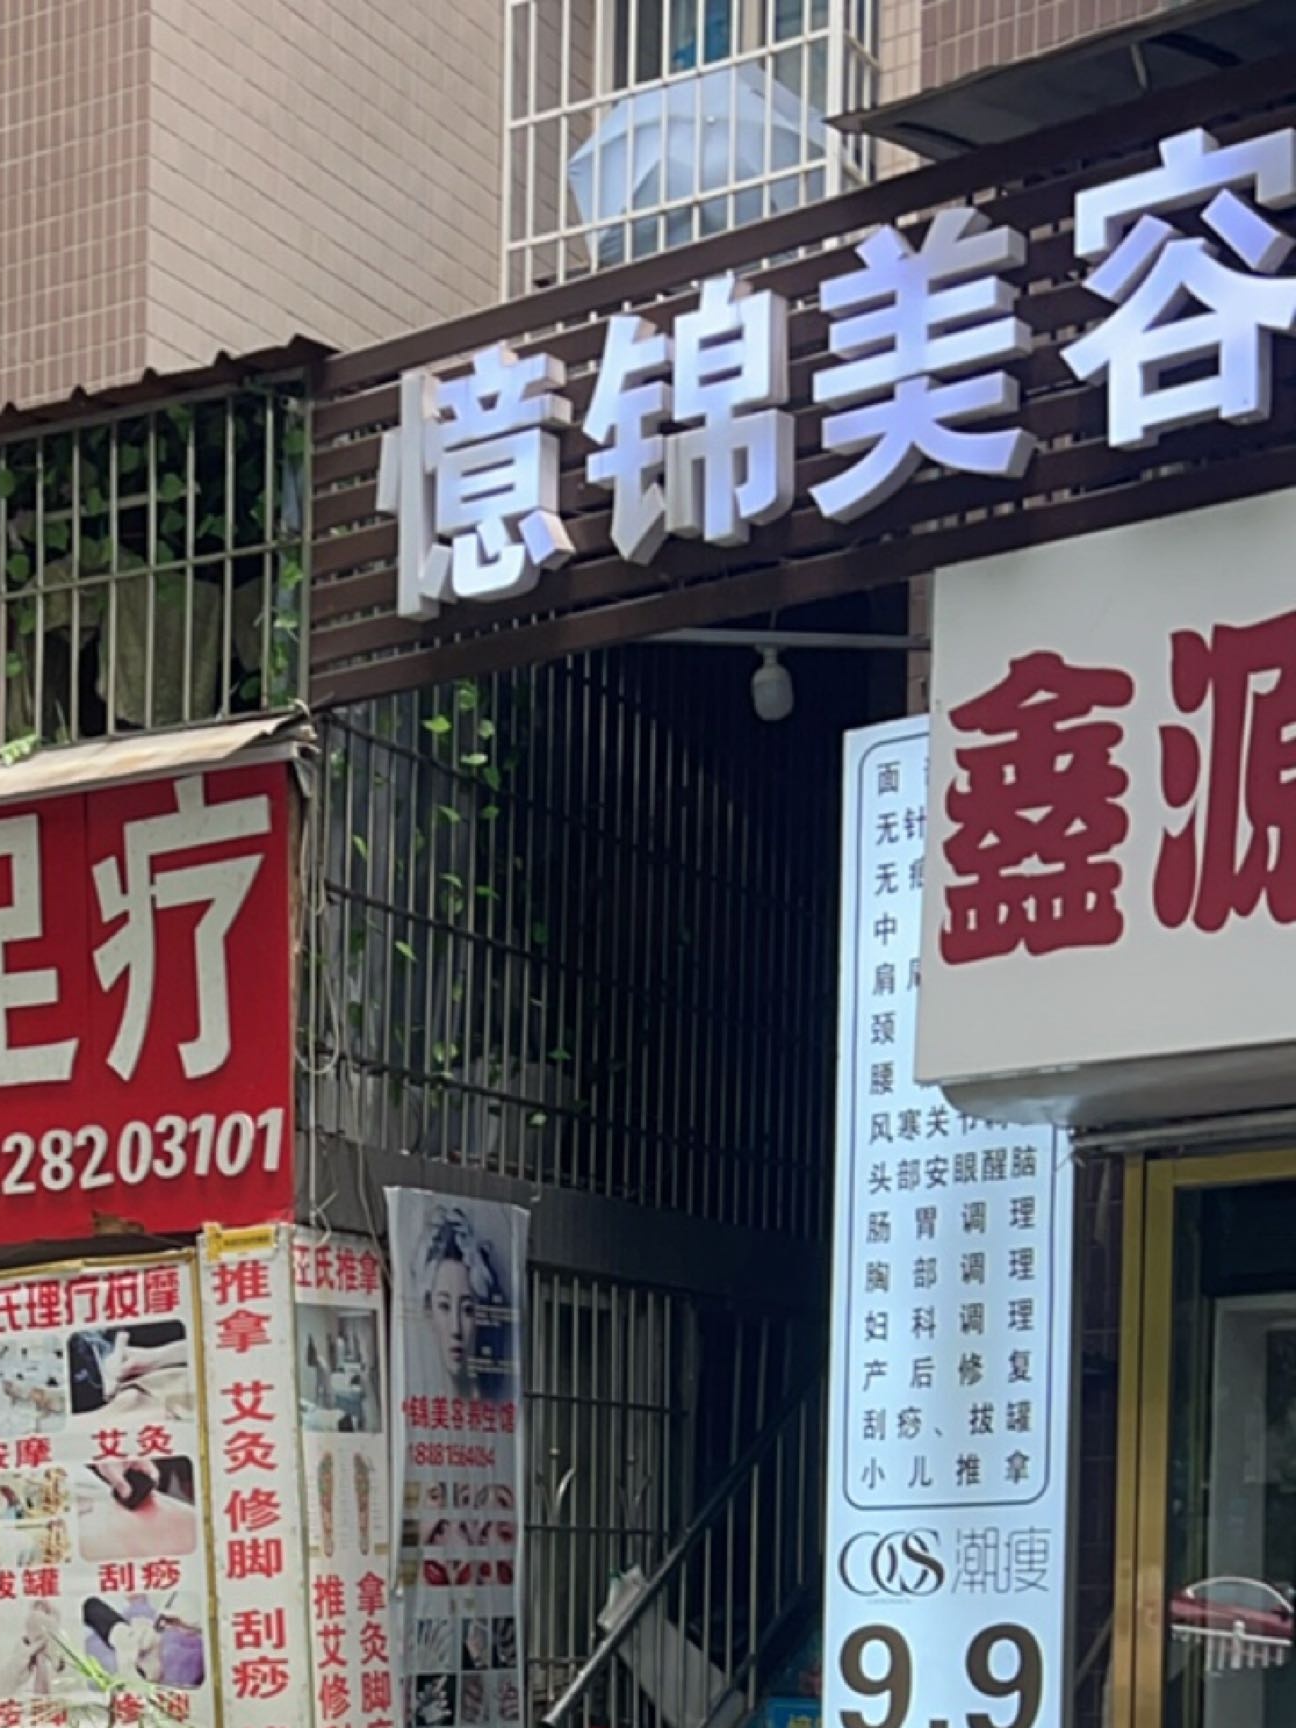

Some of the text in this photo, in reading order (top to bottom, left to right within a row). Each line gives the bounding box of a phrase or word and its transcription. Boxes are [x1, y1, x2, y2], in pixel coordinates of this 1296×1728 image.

[866, 1196, 1036, 1245] 肠胃调理
[865, 1247, 1036, 1295] 胸部调理
[865, 1297, 1035, 1343] 妇科调理
[863, 1348, 1033, 1392] 产后修复
[91, 1425, 173, 1461] 艾灸
[861, 1448, 1031, 1490] 小儿推拿
[98, 1558, 181, 1593] 刮痧
